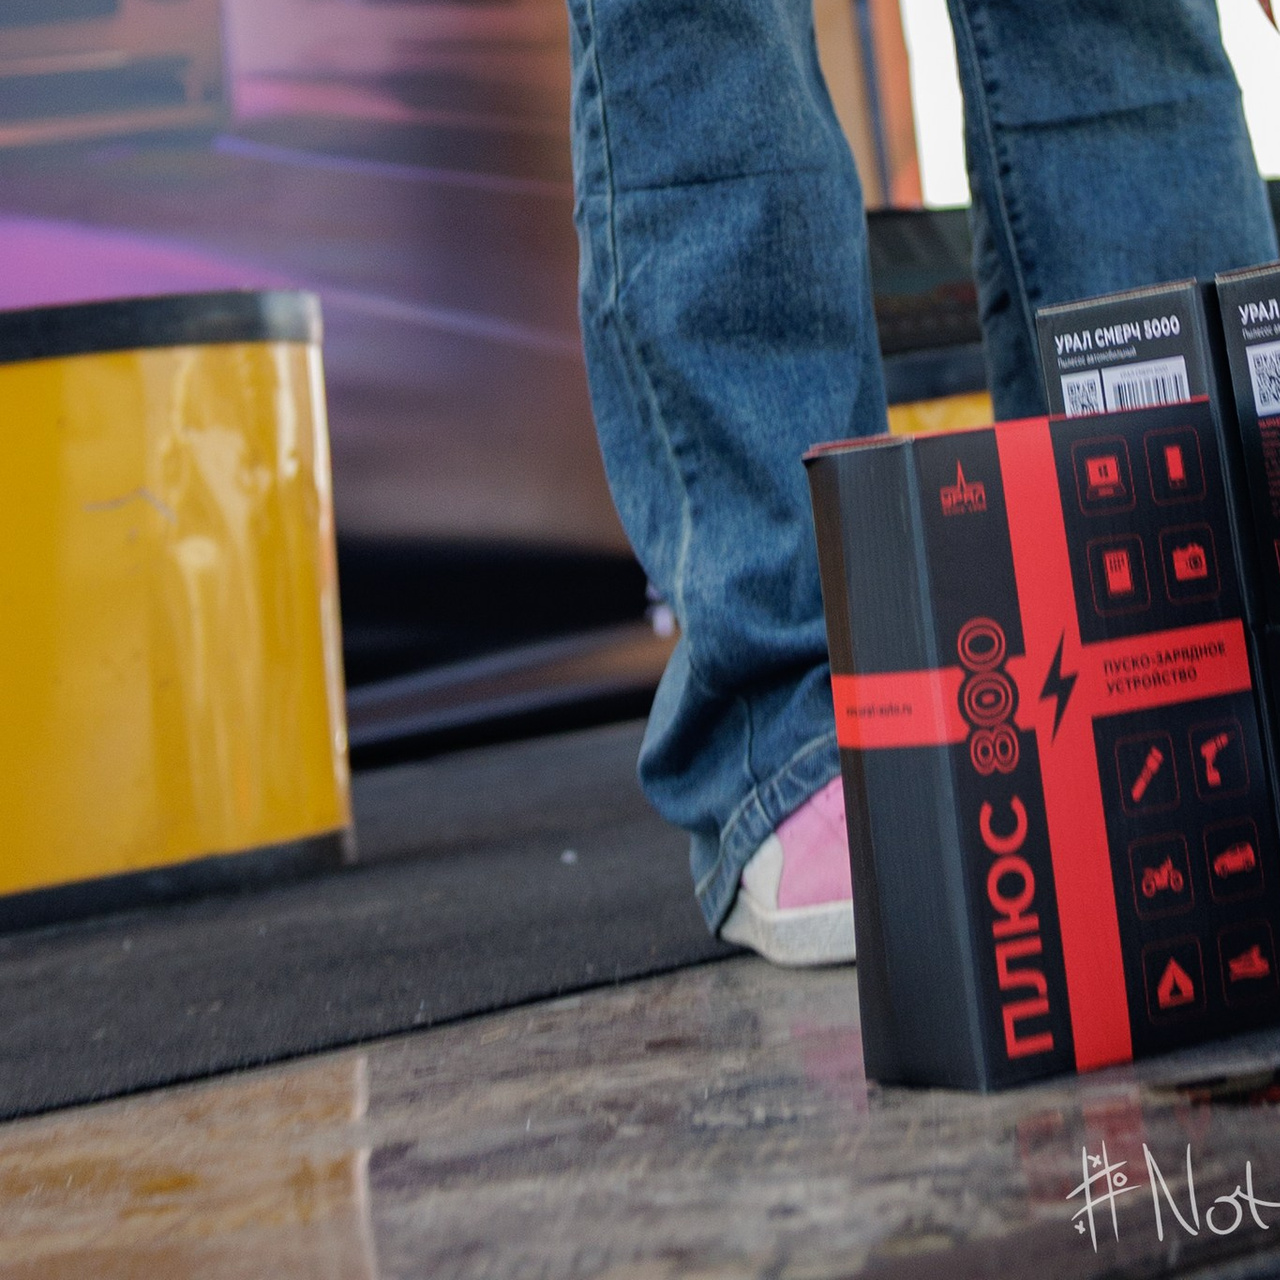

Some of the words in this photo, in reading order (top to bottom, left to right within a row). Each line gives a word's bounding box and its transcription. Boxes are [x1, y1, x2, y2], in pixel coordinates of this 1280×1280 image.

[1054, 328, 1093, 356] УРАЛ
[1094, 320, 1142, 349] СМЕРЧ
[1143, 315, 1182, 341] 5000
[1103, 639, 1226, 676] ПУСКО-ЗАРЯДНОЕ
[957, 616, 1020, 777] 800
[1107, 666, 1198, 696] УСТРОЙСТВО
[979, 795, 1055, 1061] ПЛЮС
